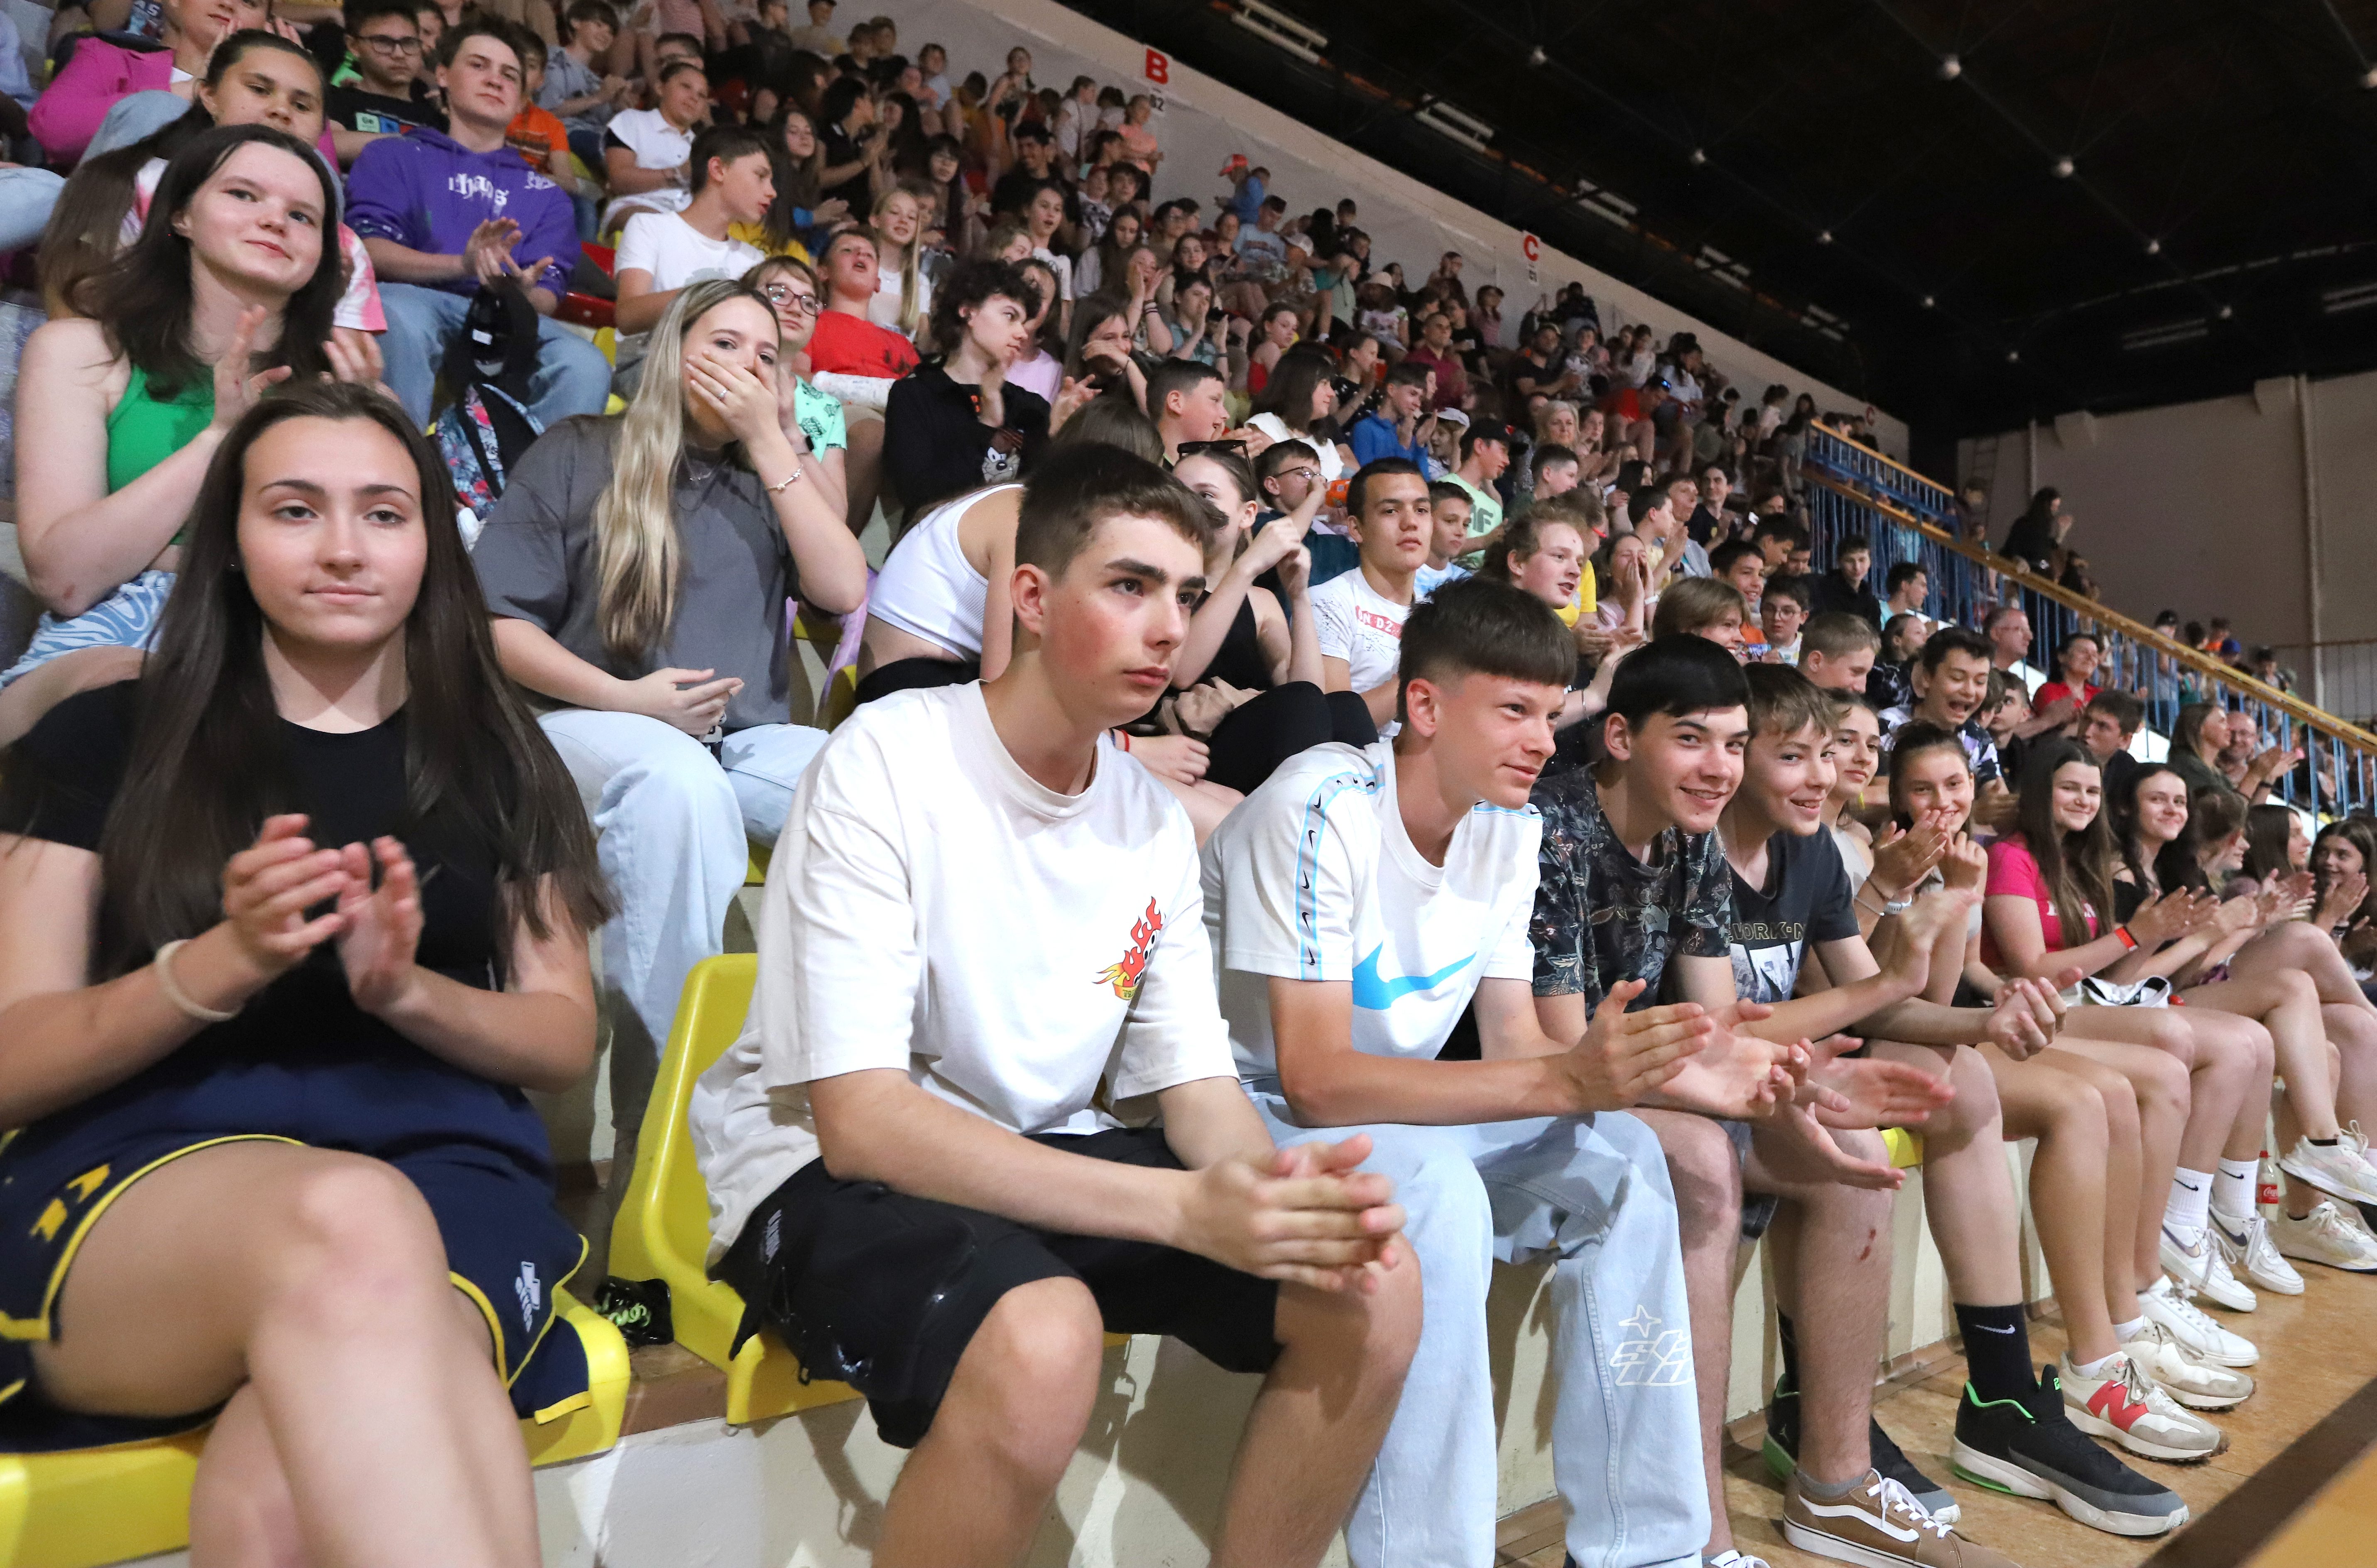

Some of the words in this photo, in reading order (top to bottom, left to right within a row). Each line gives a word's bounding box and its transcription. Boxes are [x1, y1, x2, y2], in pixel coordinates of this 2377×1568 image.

[1146, 48, 1169, 85] B
[1524, 235, 1539, 262] C
[1376, 617, 1394, 632] D2
